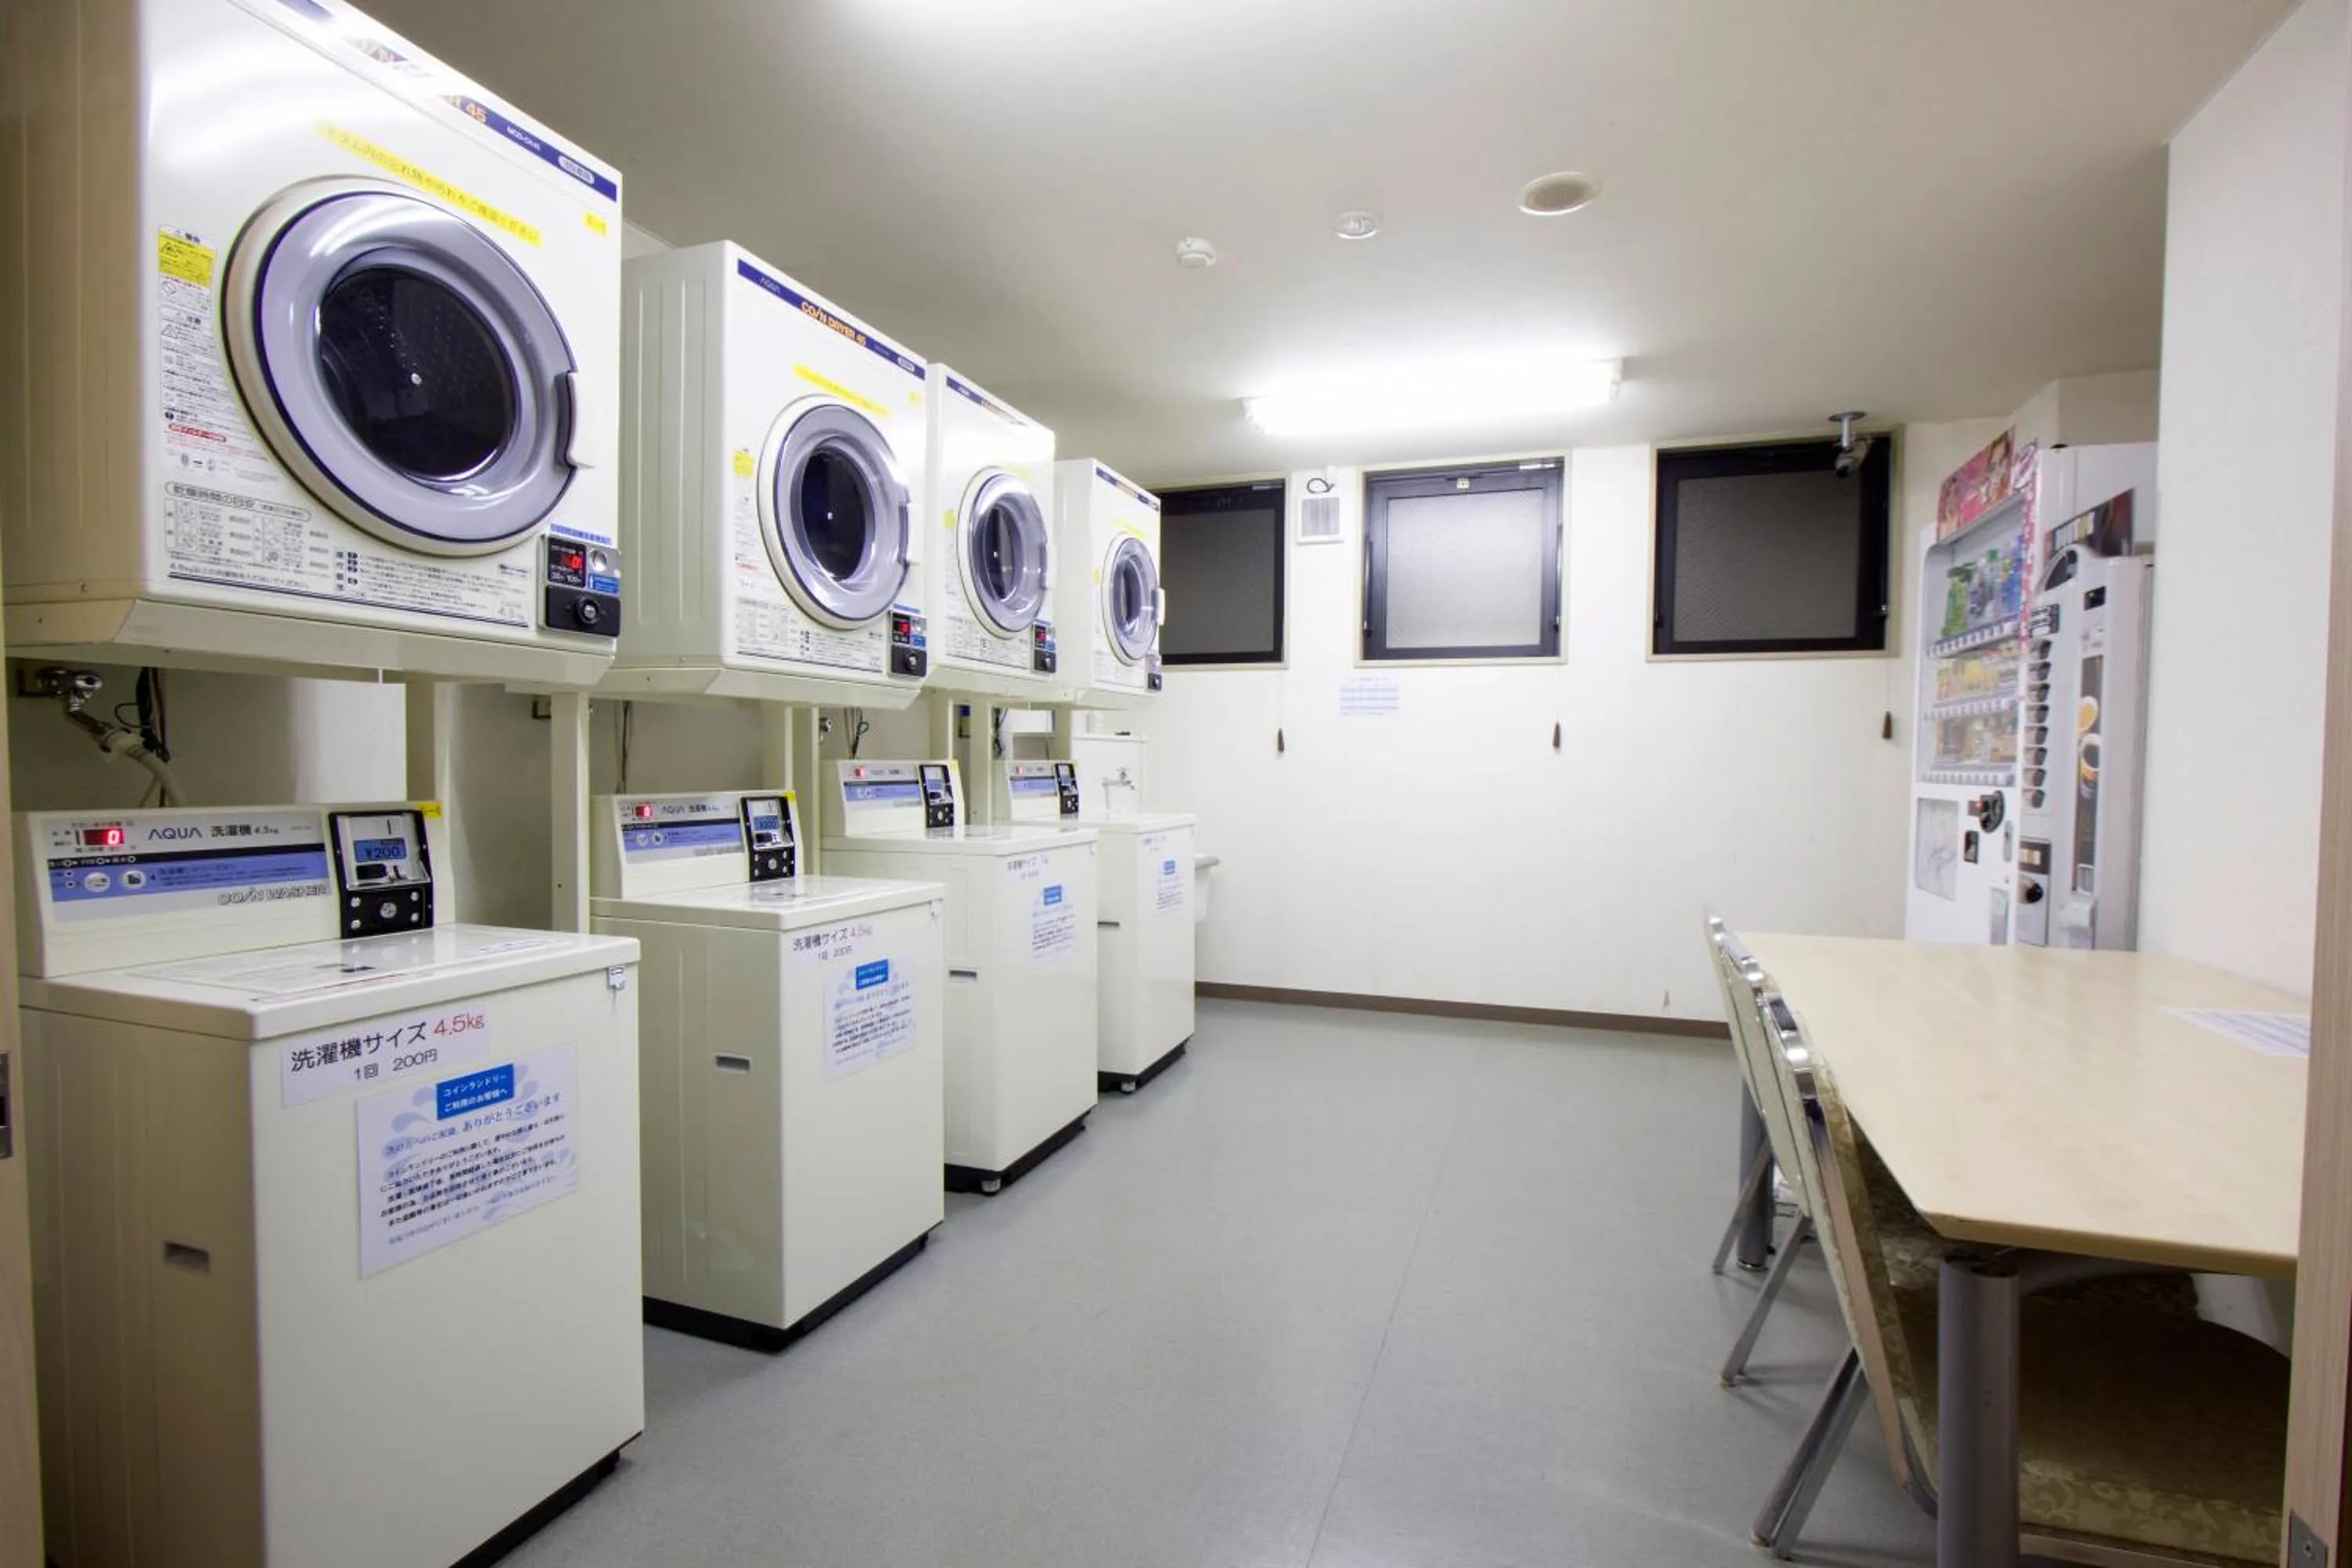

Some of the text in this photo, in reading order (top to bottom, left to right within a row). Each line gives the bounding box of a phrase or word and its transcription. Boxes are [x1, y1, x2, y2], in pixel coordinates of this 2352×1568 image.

[466, 103, 487, 124] 45
[107, 829, 120, 844] 0
[148, 827, 202, 841] AQUA
[210, 824, 252, 837] 洗濯機
[290, 1012, 486, 1073] 洗濯機サイズ 4.5kg
[354, 1048, 437, 1080] 1回 200円
[443, 1073, 508, 1097] コインランドリー
